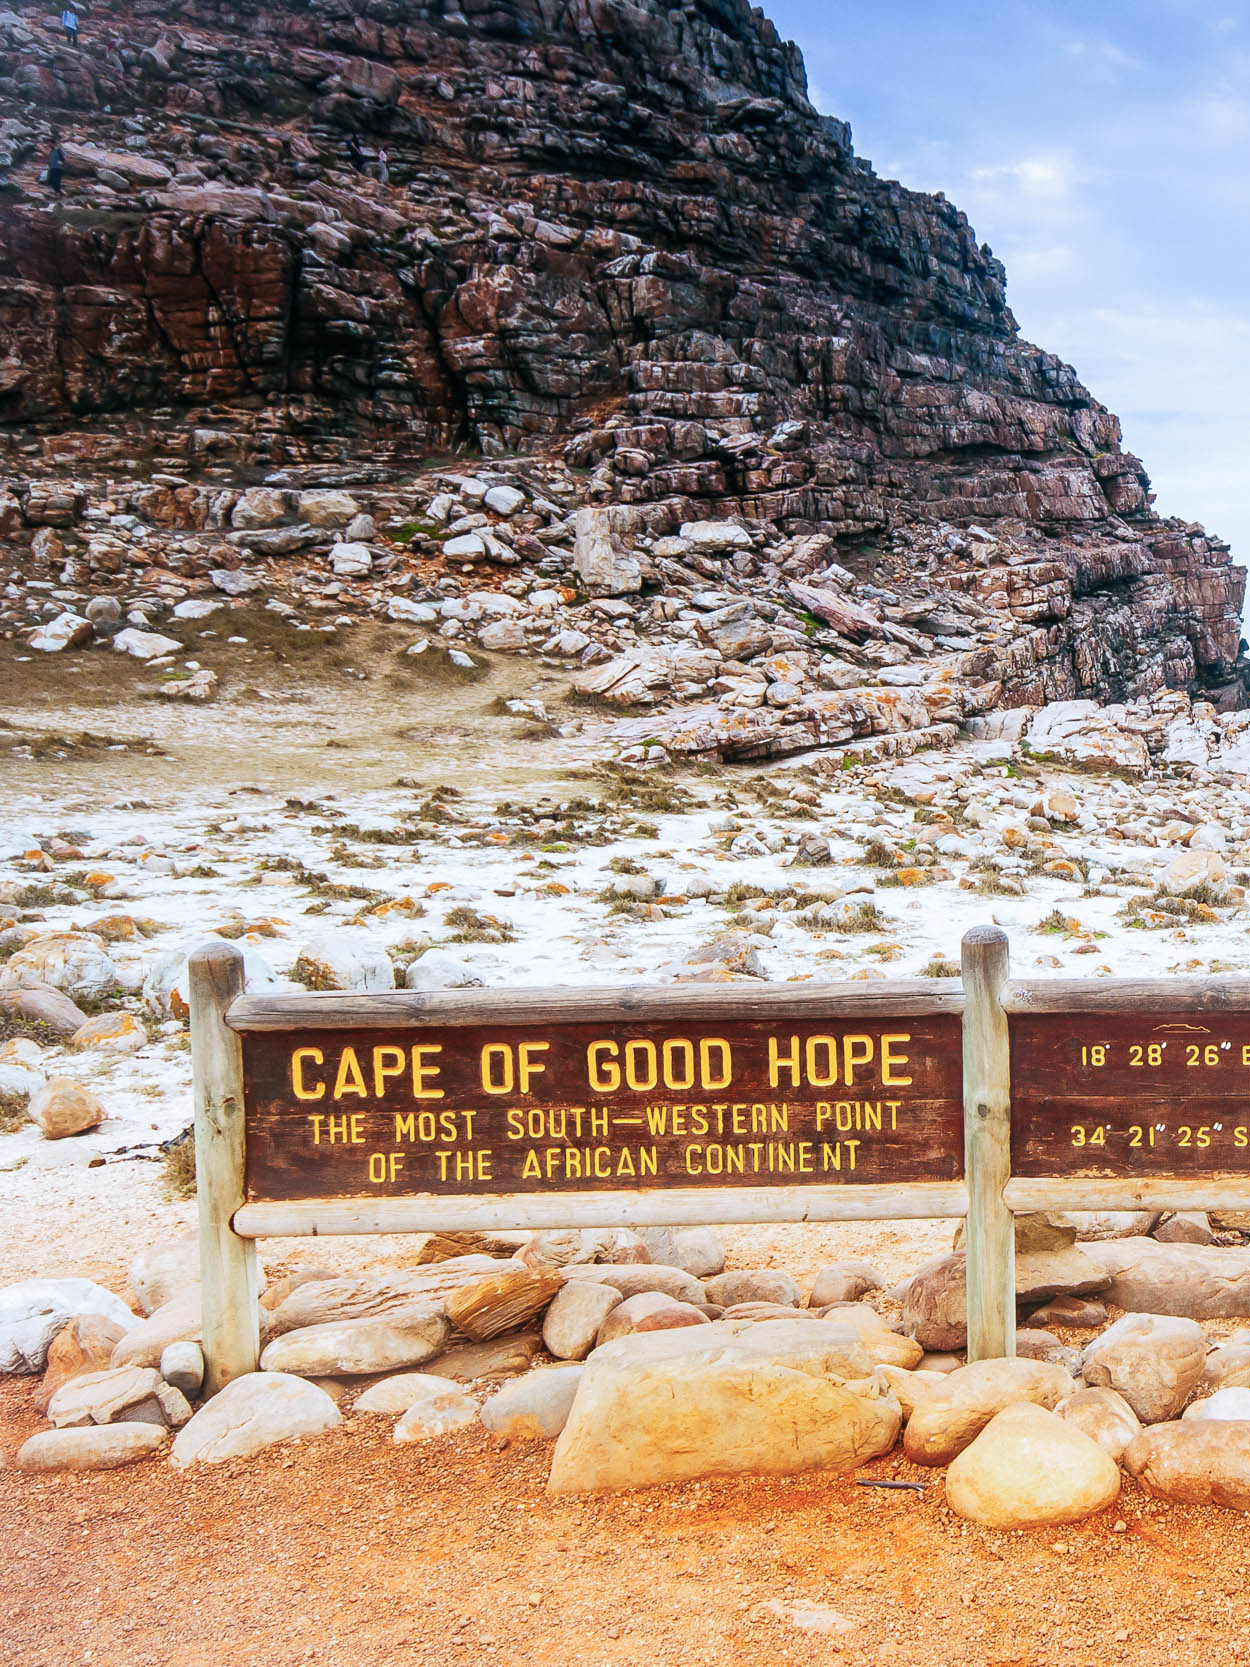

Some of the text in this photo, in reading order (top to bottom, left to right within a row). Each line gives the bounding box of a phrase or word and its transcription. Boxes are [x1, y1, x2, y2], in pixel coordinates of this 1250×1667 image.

[291, 1033, 913, 1101] CAPE OF GOOD HOPE
[307, 1113, 367, 1145] THE
[394, 1110, 477, 1143] MOST
[816, 1100, 902, 1132] POINT
[368, 1139, 861, 1184] OF THE AFRICAN CONTINENT
